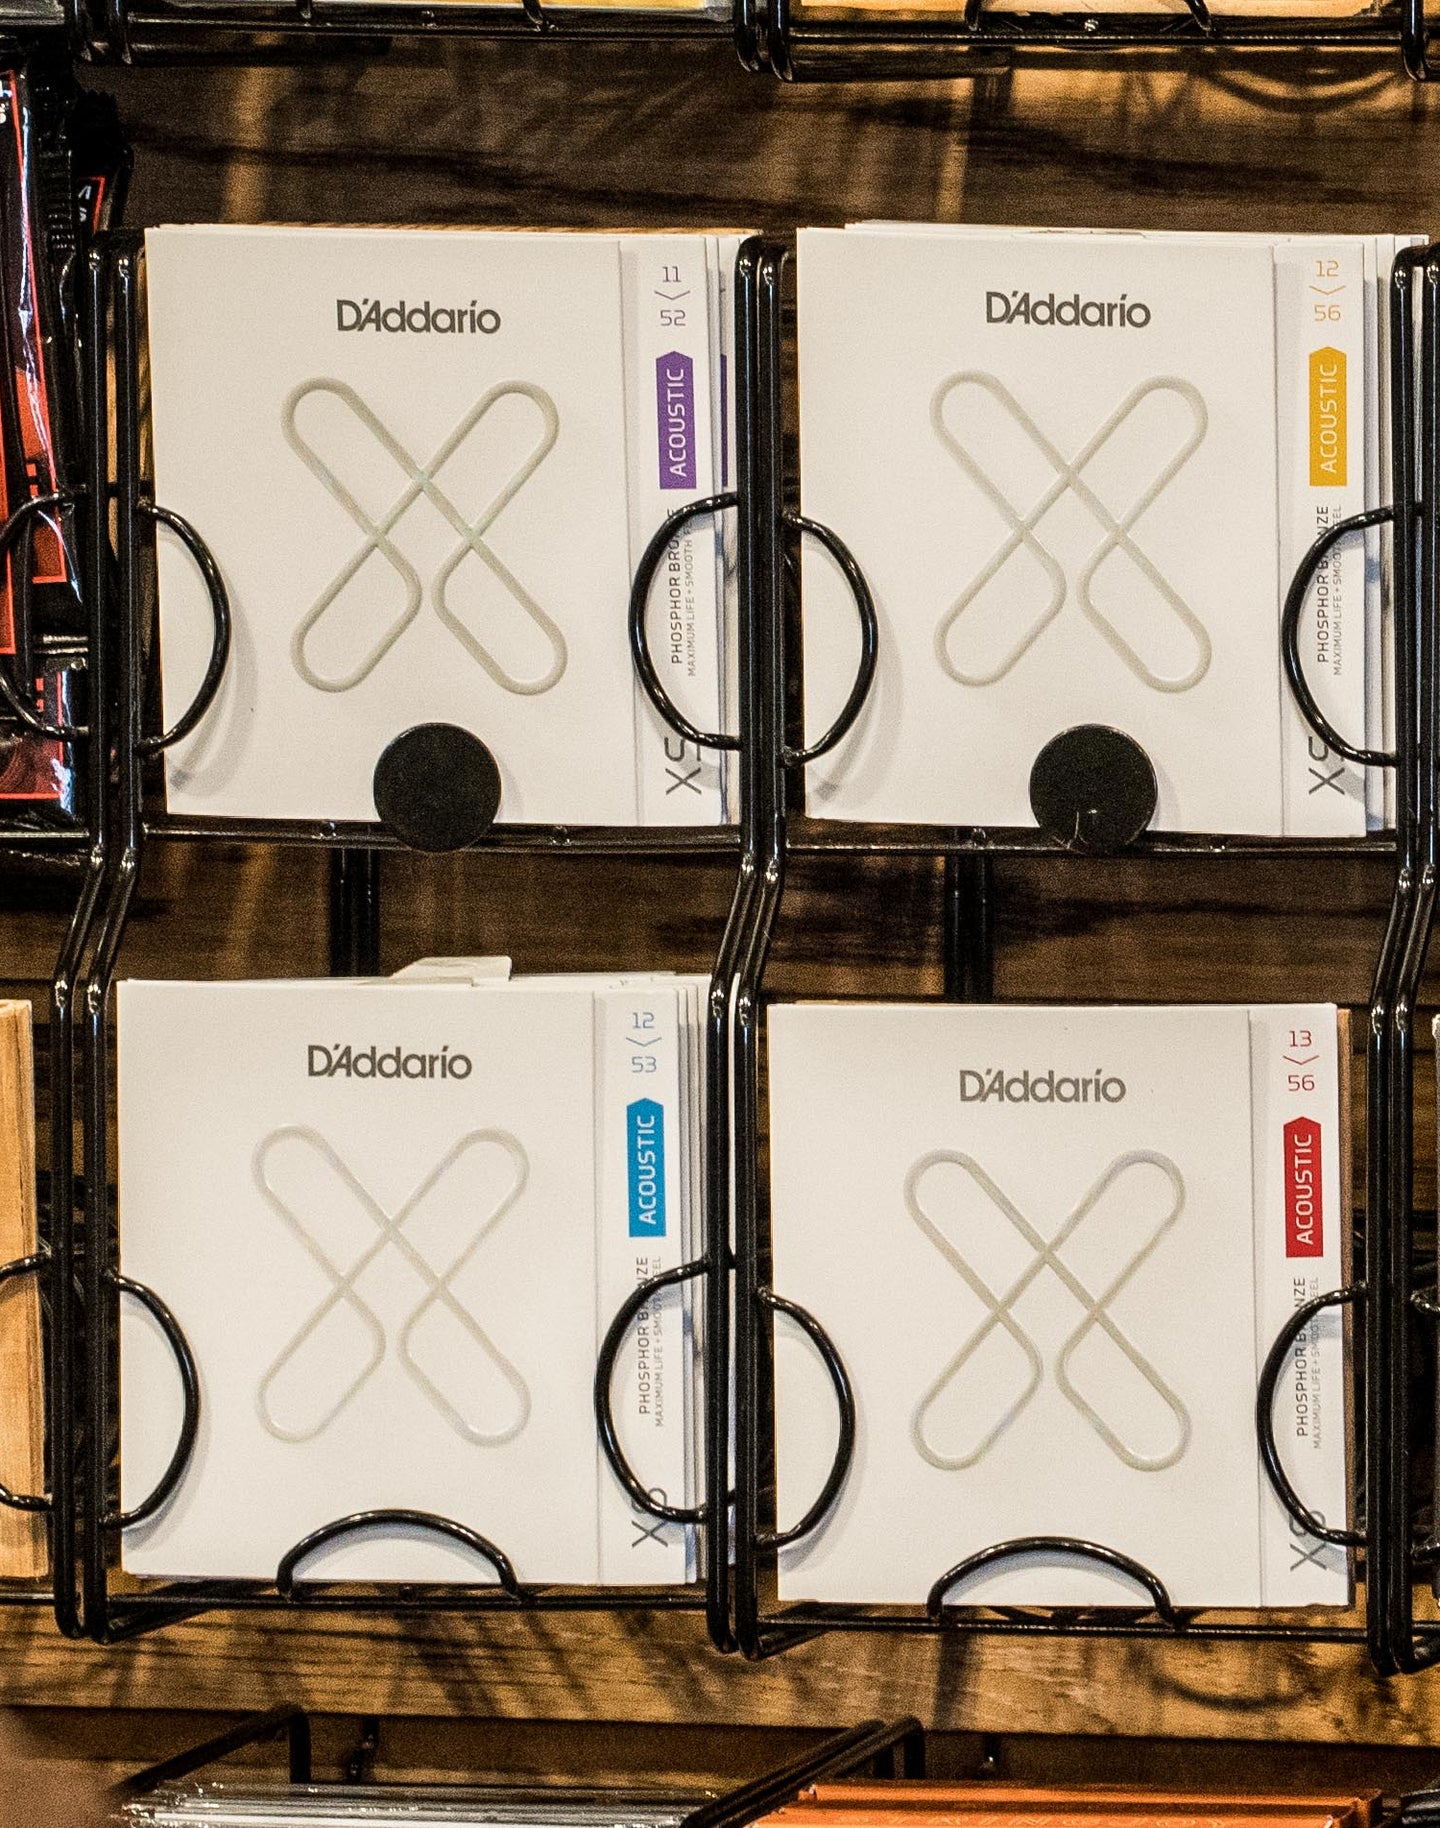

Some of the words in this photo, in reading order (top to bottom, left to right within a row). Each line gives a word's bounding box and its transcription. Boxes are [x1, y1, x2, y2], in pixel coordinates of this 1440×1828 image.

[662, 266, 682, 283] 11
[1316, 260, 1340, 278] 12
[336, 298, 501, 334] D'Addario
[660, 309, 686, 327] 52
[986, 290, 1151, 328] D'Addario
[1314, 304, 1342, 322] 56
[666, 368, 687, 477] ACOUSTIC
[1320, 364, 1337, 474] ACOUSTIC
[668, 575, 683, 664] PHOSPHOR
[1317, 578, 1330, 663] PHOSPHOR
[632, 1012, 655, 1029] 12
[1289, 1030, 1312, 1047] 13
[307, 1043, 472, 1080] D'Addario
[631, 1056, 657, 1073] 53
[959, 1067, 1126, 1103] D'Addario
[1287, 1075, 1315, 1092] 56
[637, 1115, 657, 1225] ACOUSTIC
[1294, 1134, 1314, 1245] ACOUSTIC
[637, 1325, 650, 1414] PHOSPHOR
[1295, 1346, 1308, 1437] PHOSPHOR
